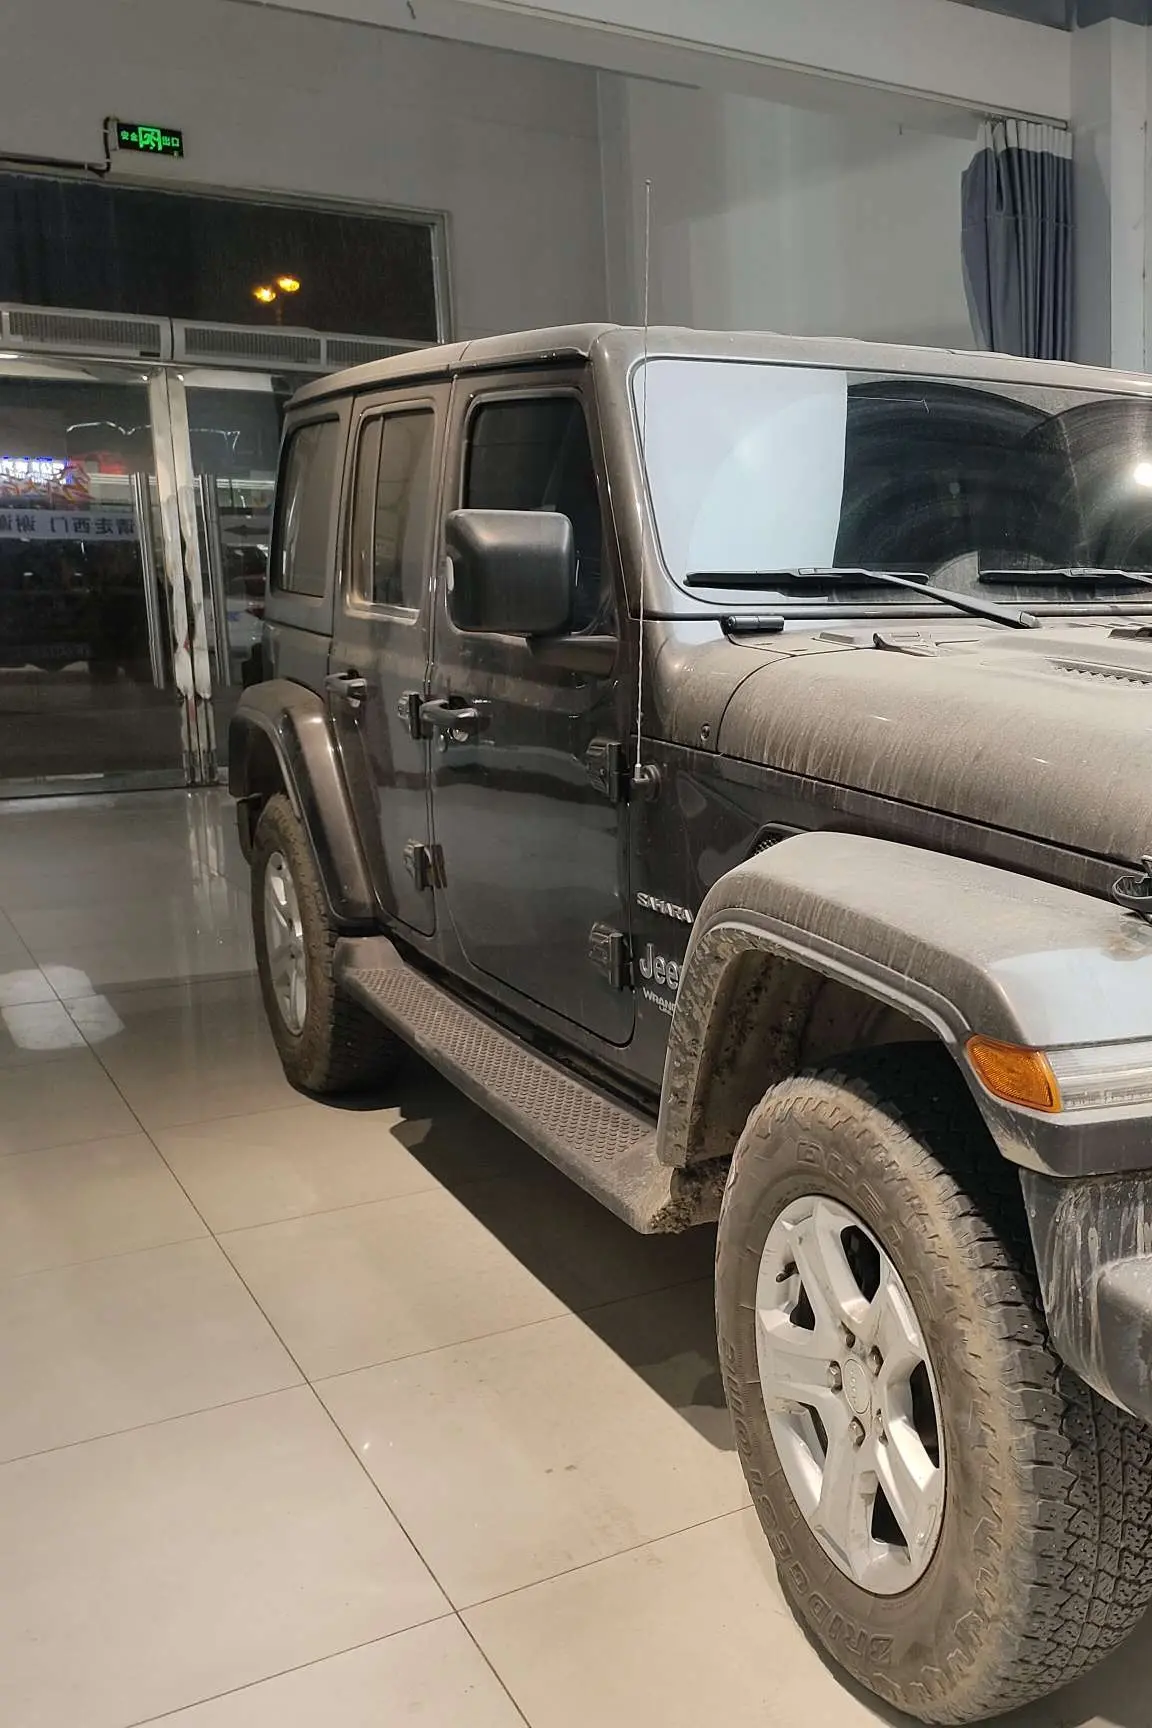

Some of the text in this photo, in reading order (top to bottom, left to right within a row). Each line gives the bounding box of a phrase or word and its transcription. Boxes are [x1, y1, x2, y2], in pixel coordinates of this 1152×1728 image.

[120, 130, 180, 147] 安全 出口
[636, 892, 694, 923] SAHARA
[640, 943, 682, 990] Jee
